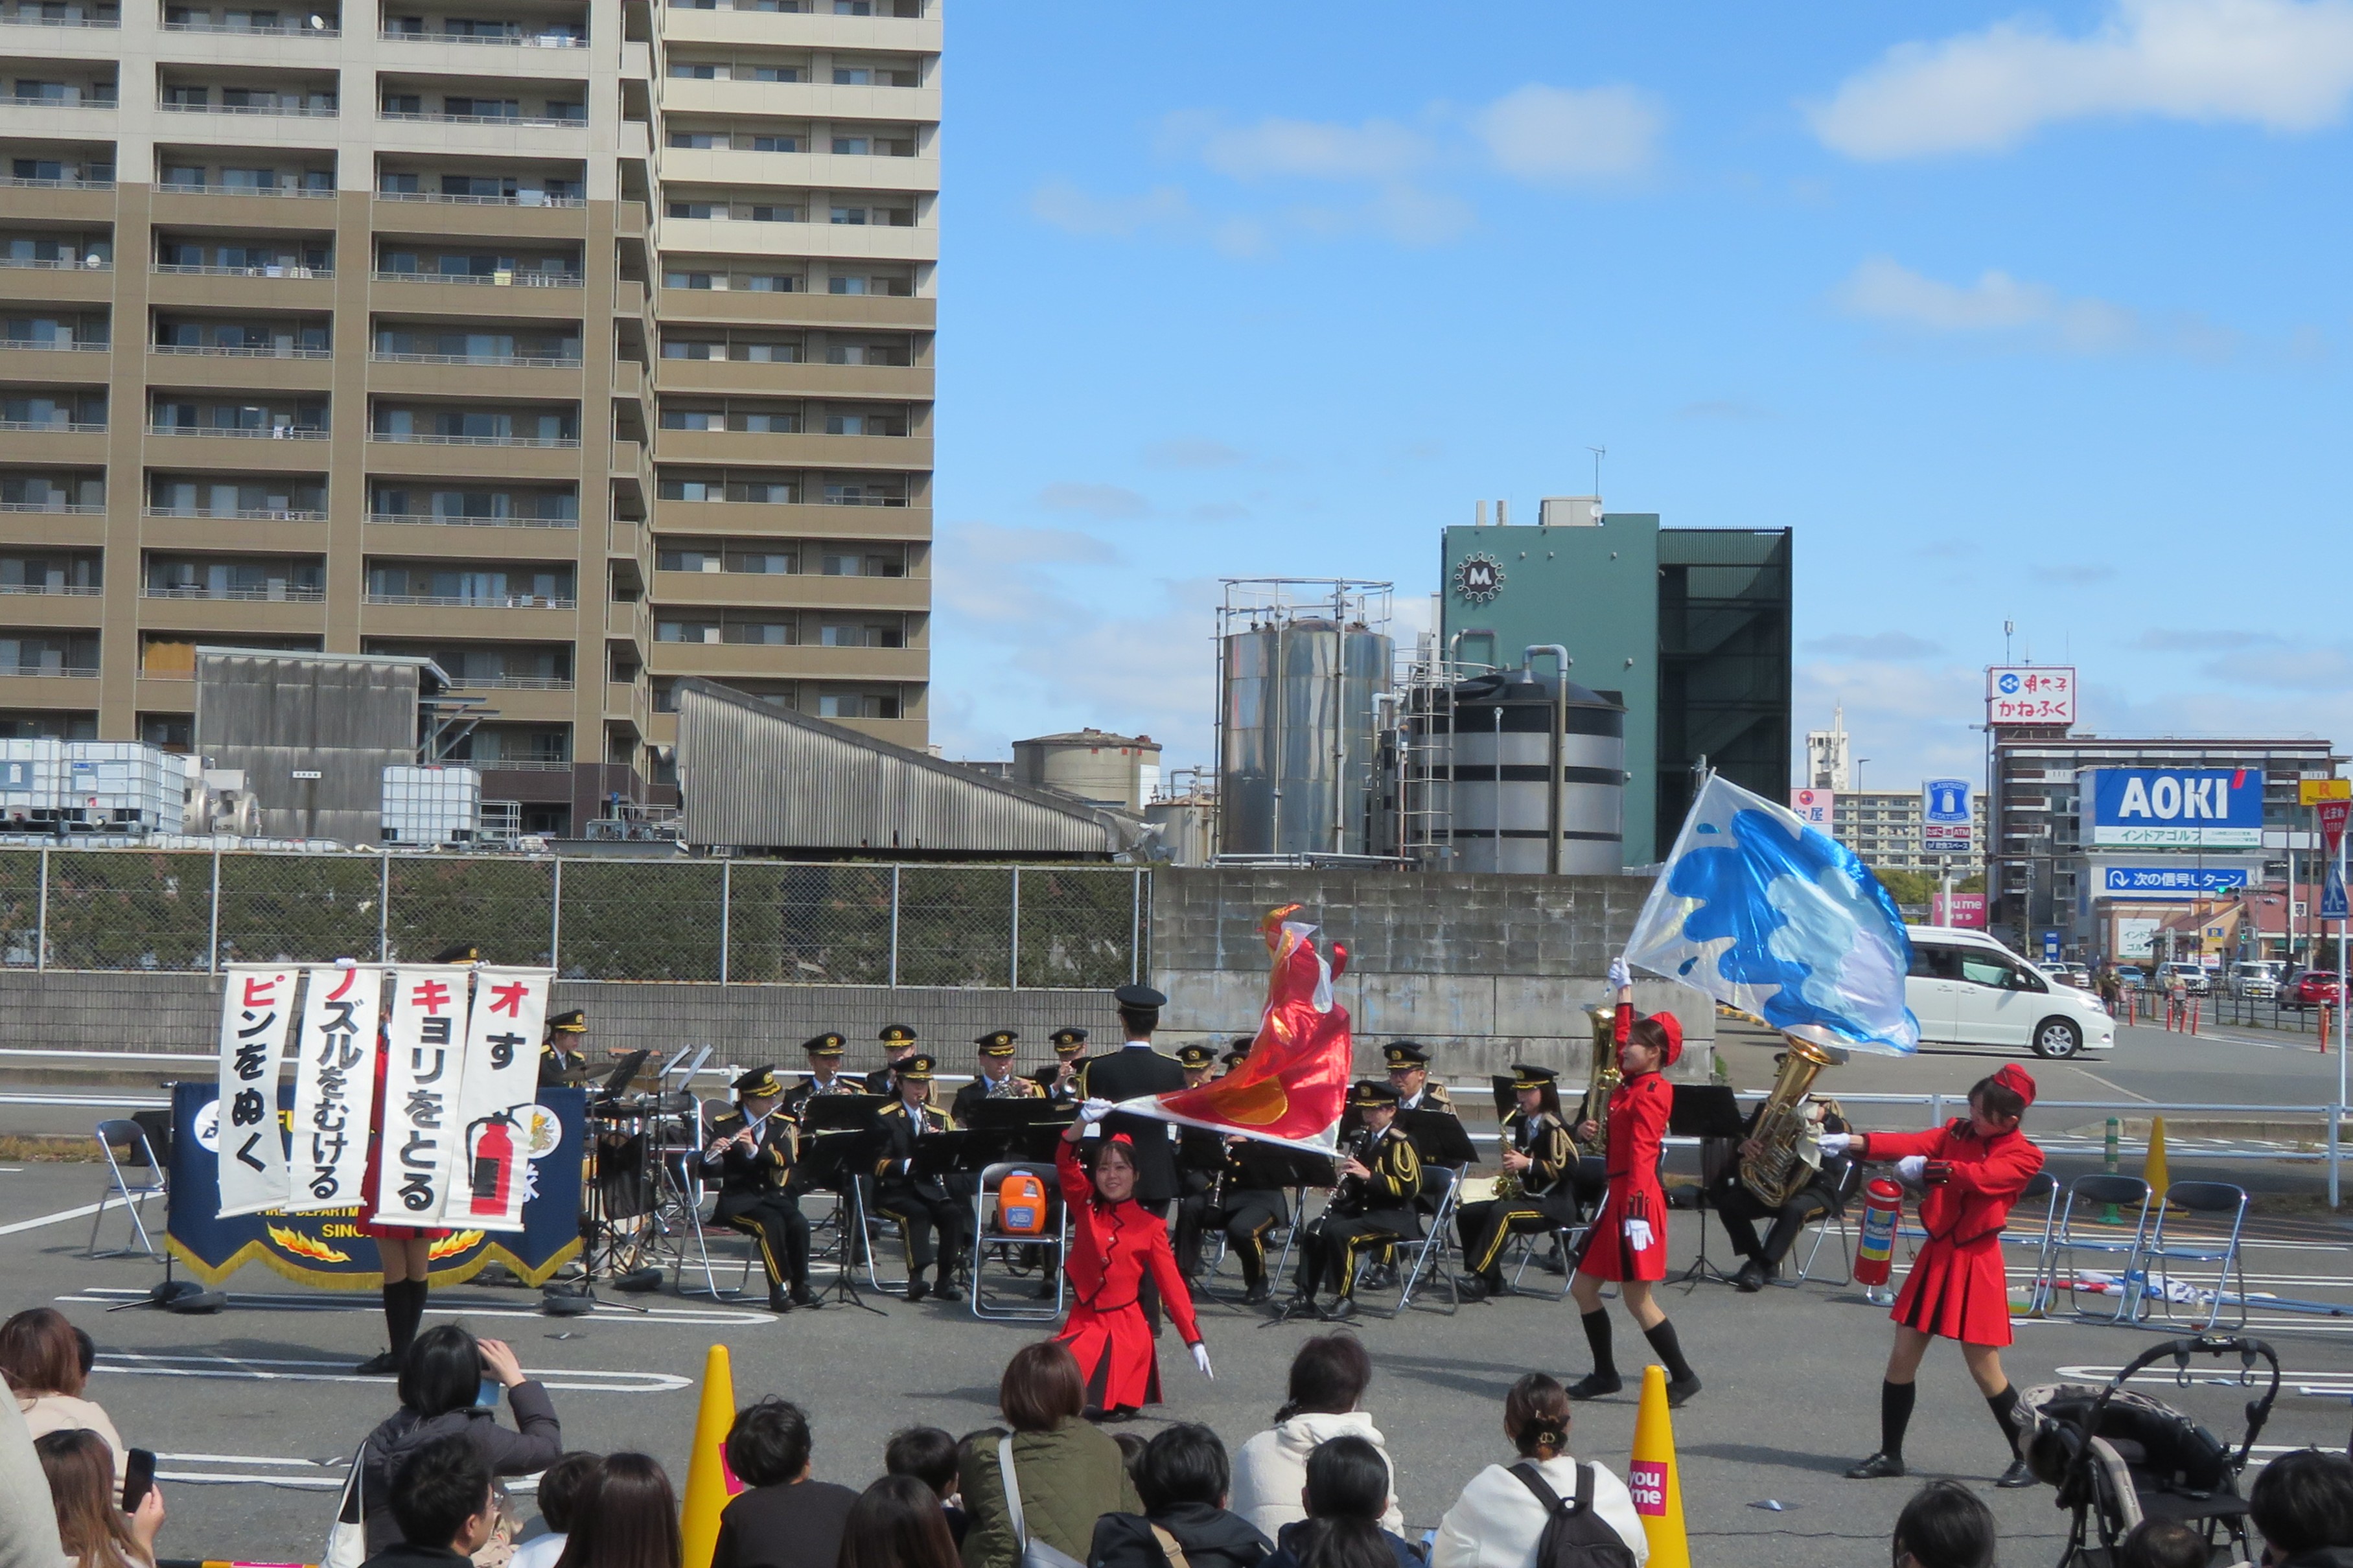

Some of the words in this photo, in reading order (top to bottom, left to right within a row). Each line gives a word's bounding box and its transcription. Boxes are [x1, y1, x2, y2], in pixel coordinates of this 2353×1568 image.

[1469, 568, 1492, 584] M
[2024, 674, 2067, 695] 明太子
[1999, 700, 2067, 717] かねふく
[2118, 776, 2228, 820] AOKI
[2323, 807, 2345, 820] 止まれ
[2121, 829, 2201, 842] インドアゴルフ
[1938, 901, 1983, 912] yume
[486, 980, 529, 1070] オす
[231, 974, 286, 1173] ピンをぬく
[308, 968, 364, 1199] ノズルをむける
[397, 978, 452, 1211] キョリをとる
[322, 1224, 372, 1238] SINC
[1629, 1471, 1660, 1488] you
[1631, 1490, 1662, 1505] me
